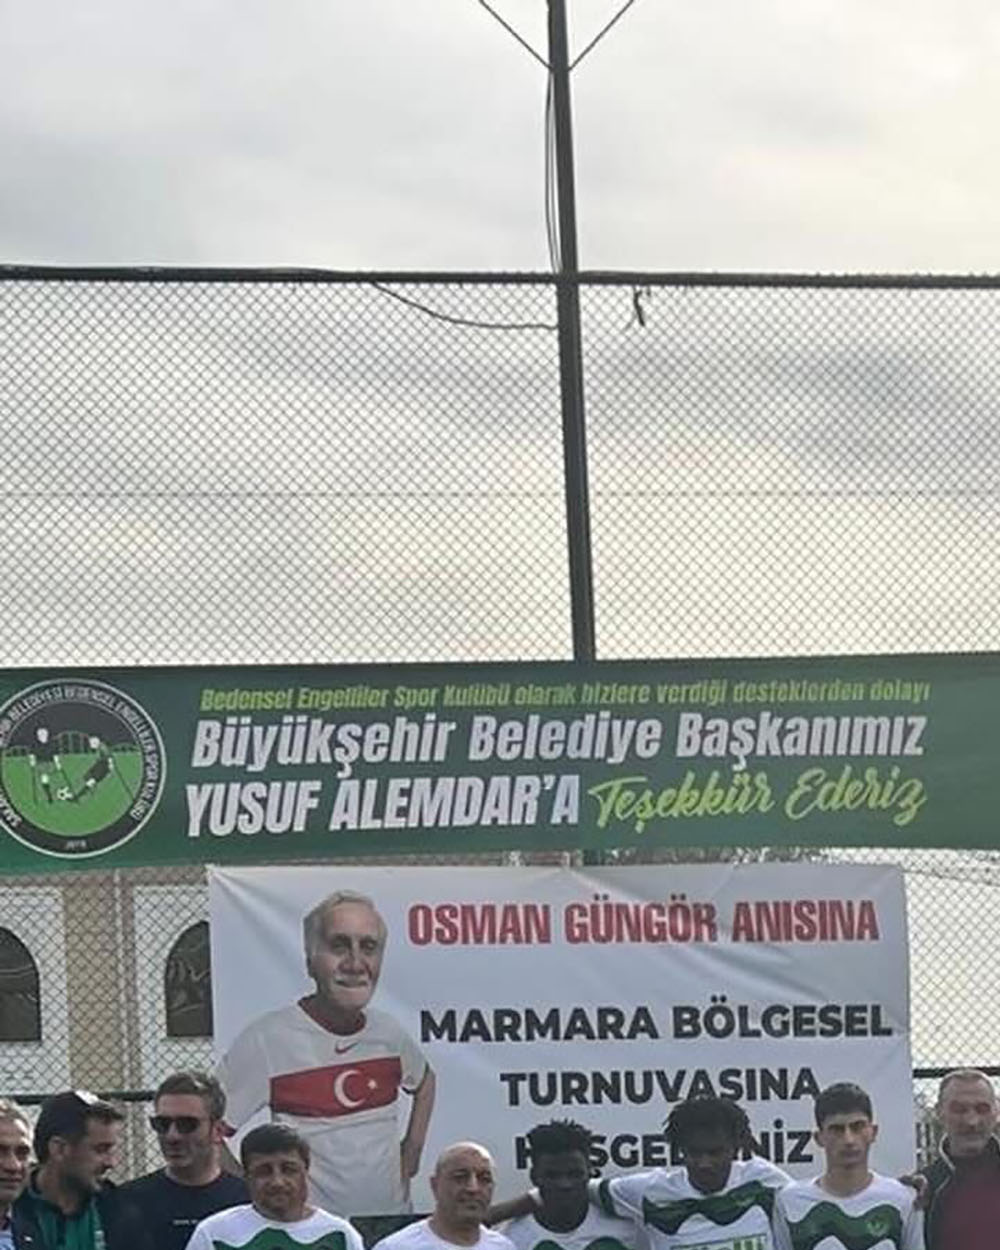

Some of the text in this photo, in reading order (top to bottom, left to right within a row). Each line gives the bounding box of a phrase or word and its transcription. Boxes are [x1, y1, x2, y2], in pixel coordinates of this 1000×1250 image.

[200, 676, 932, 712] Bedensel Engelliler Spor Kulübü olarak bizlere verdiği desteklerden dolayı
[191, 711, 928, 777] Büyükşehir Belediye Başkanımız
[186, 780, 323, 838] YUSUF
[587, 769, 776, 833] Teşekkür
[784, 765, 928, 827] Ederiz
[408, 893, 880, 946] OSMAN GÜNGÖR ANISINA
[420, 994, 893, 1044] MARMARA BÖLGESEL
[500, 1067, 821, 1107] TURNUVASINA
